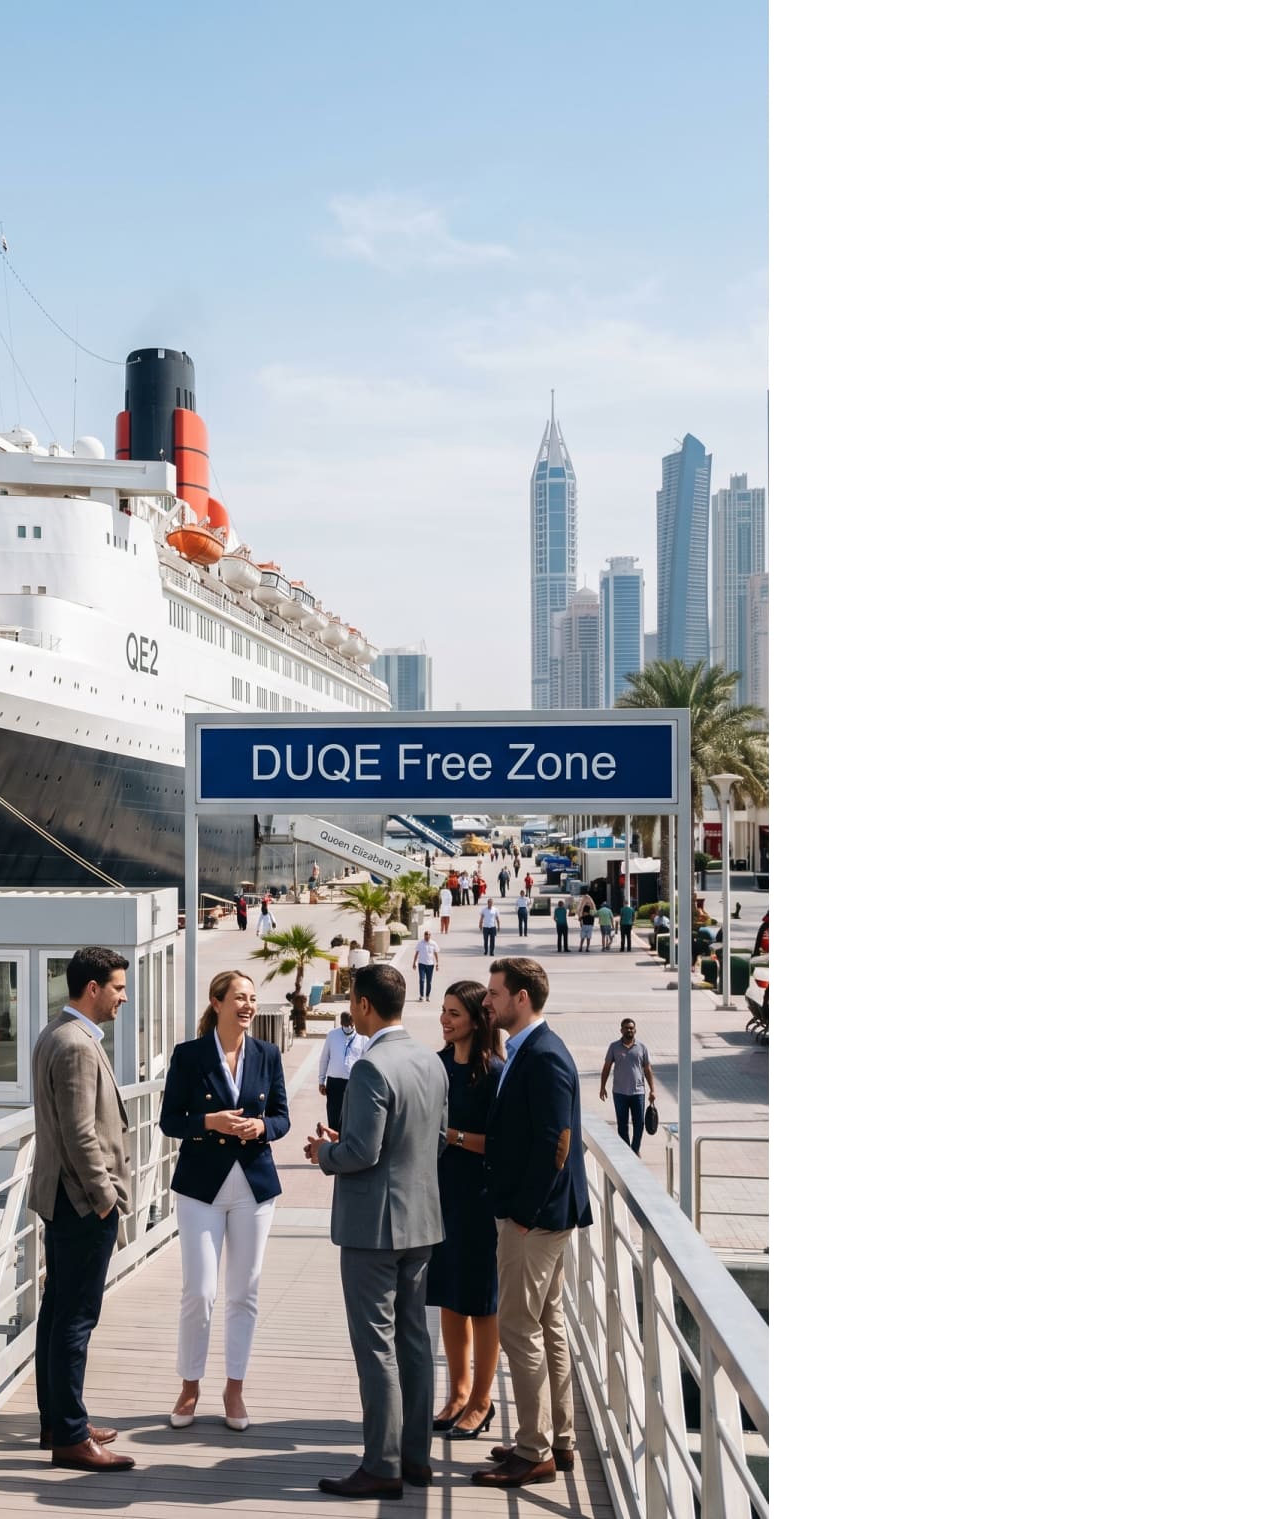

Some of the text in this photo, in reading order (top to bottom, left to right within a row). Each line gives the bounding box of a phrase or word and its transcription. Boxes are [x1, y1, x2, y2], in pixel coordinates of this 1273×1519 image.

[126, 632, 158, 676] QE2
[252, 743, 616, 783] DUQE Free Zone
[393, 864, 401, 873] 2
